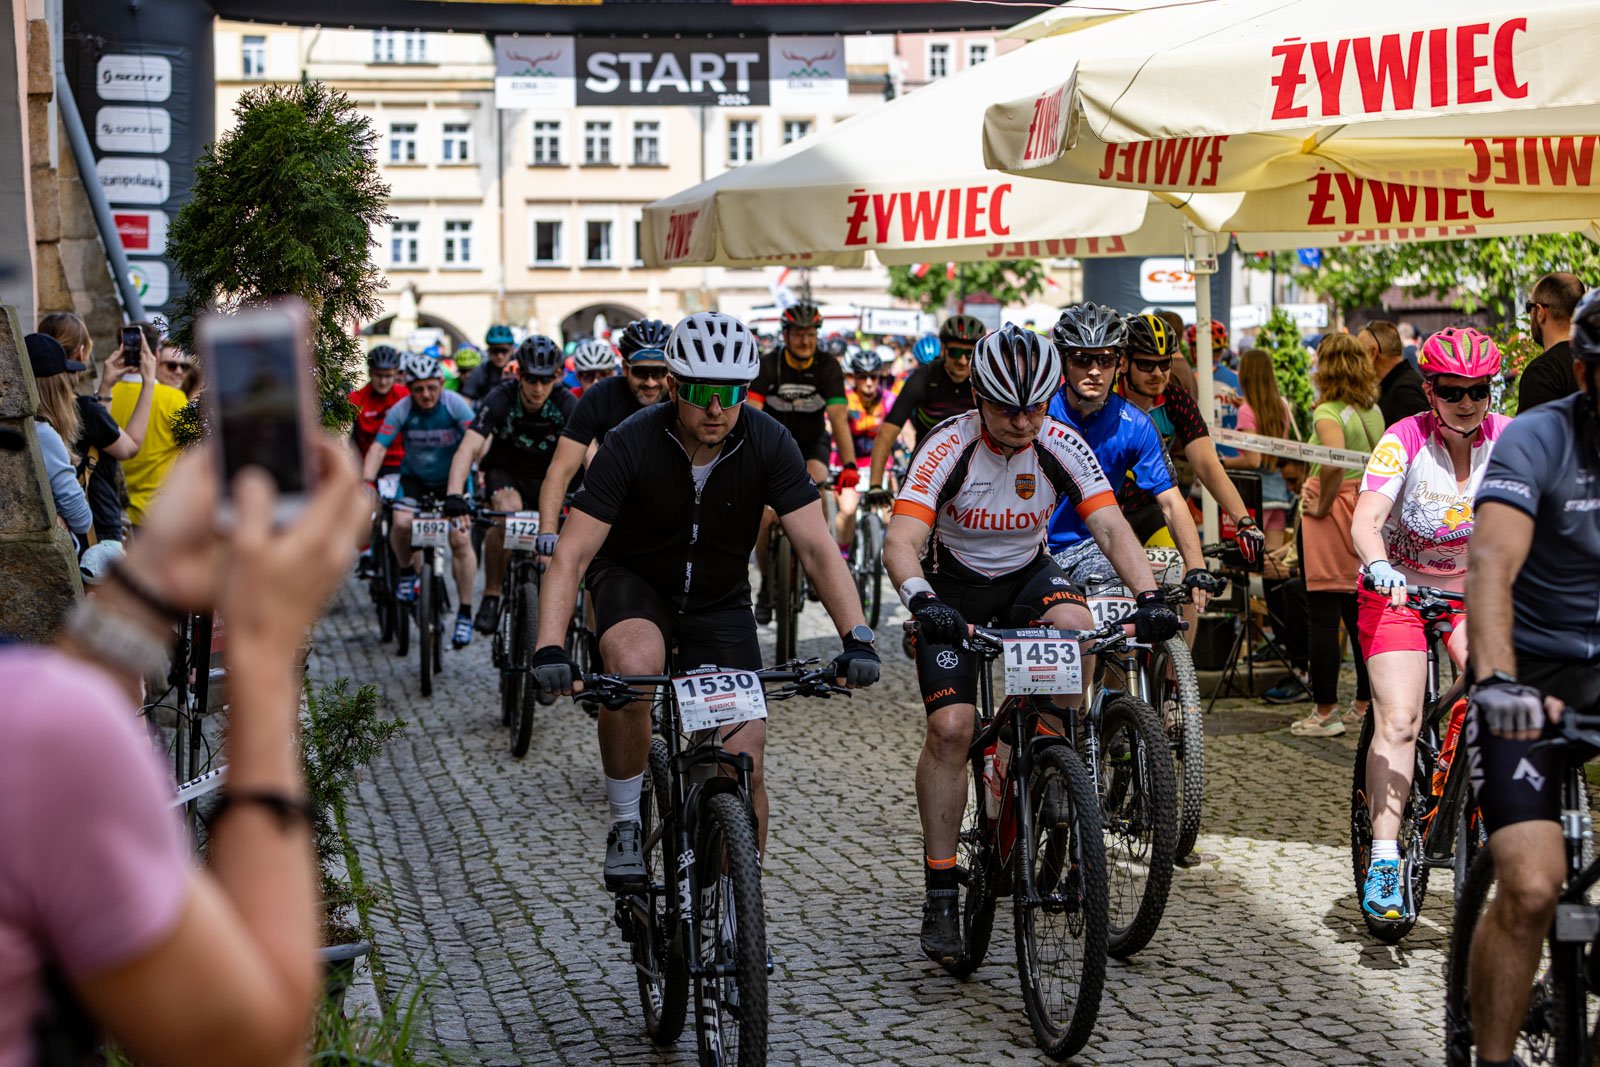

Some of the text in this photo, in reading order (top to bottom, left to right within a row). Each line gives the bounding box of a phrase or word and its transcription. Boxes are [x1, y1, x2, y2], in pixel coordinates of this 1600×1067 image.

[585, 52, 760, 94] START
[1271, 18, 1528, 120] ŻYWIEC
[717, 94, 750, 106] 2024
[844, 188, 1012, 246] ŻYWIEC
[911, 434, 960, 496] Mitutoyo
[416, 522, 446, 533] 1692
[946, 503, 1054, 532] Mitutoyo
[1093, 602, 1138, 622] 152
[1010, 643, 1076, 665] 1453
[681, 674, 754, 698] 1530
